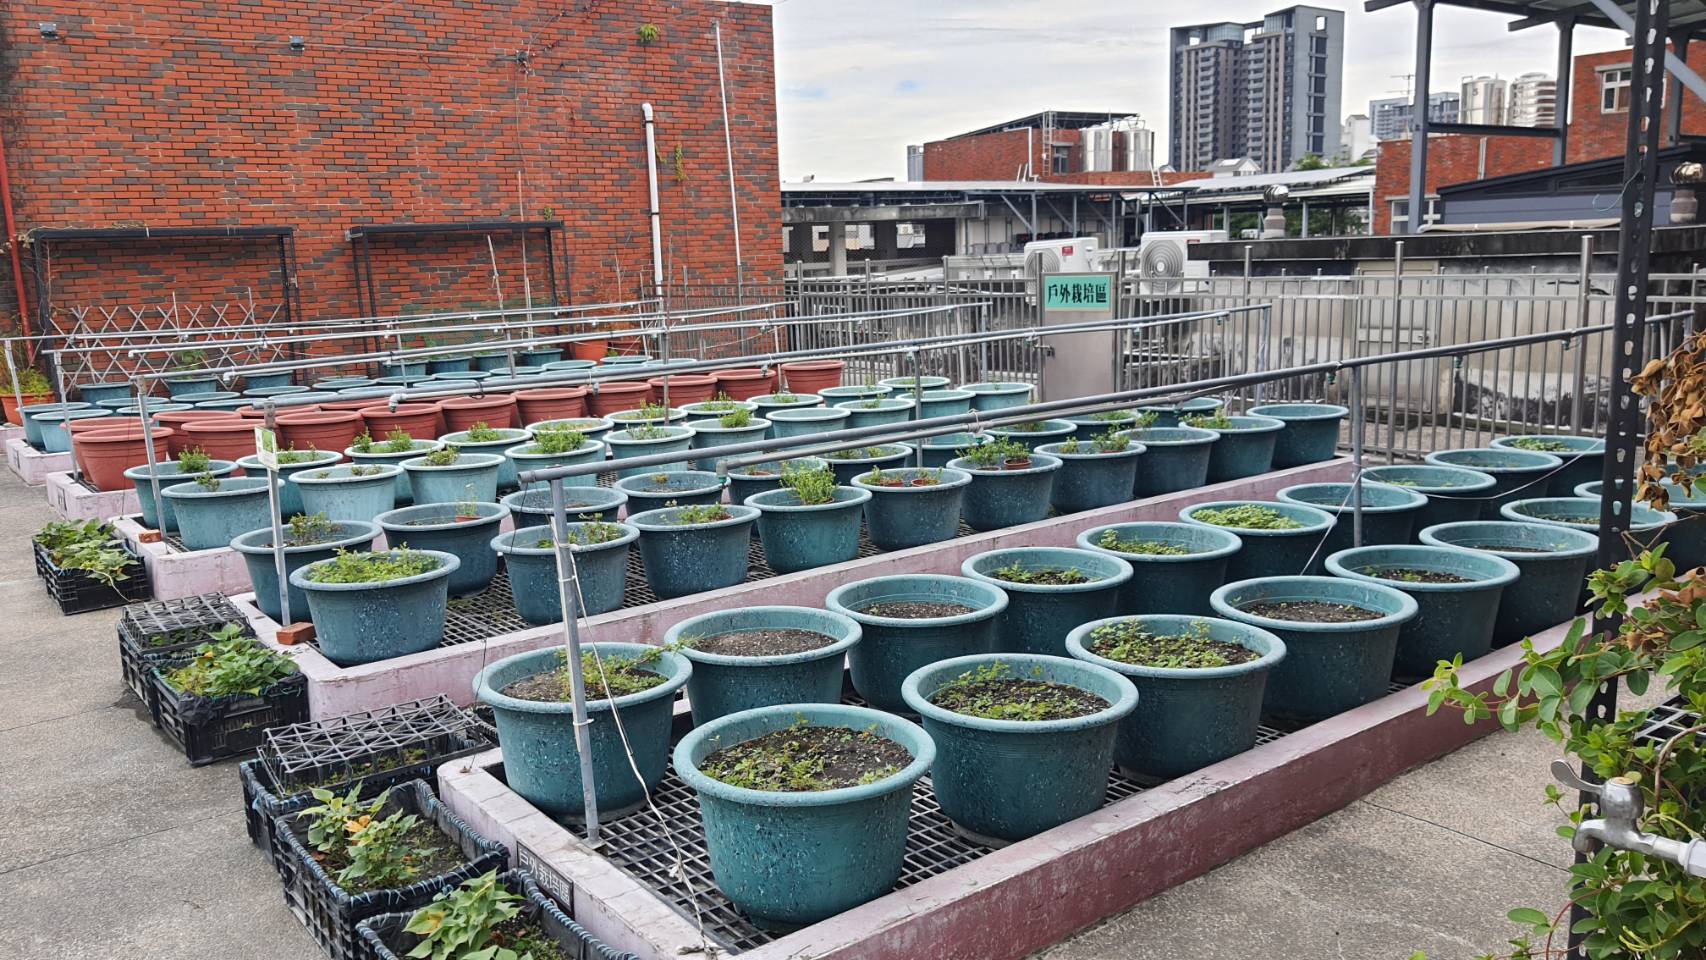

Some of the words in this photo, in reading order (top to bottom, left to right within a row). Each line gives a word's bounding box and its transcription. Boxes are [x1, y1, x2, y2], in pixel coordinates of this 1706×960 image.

[1048, 283, 1107, 304] 戶外栽培區
